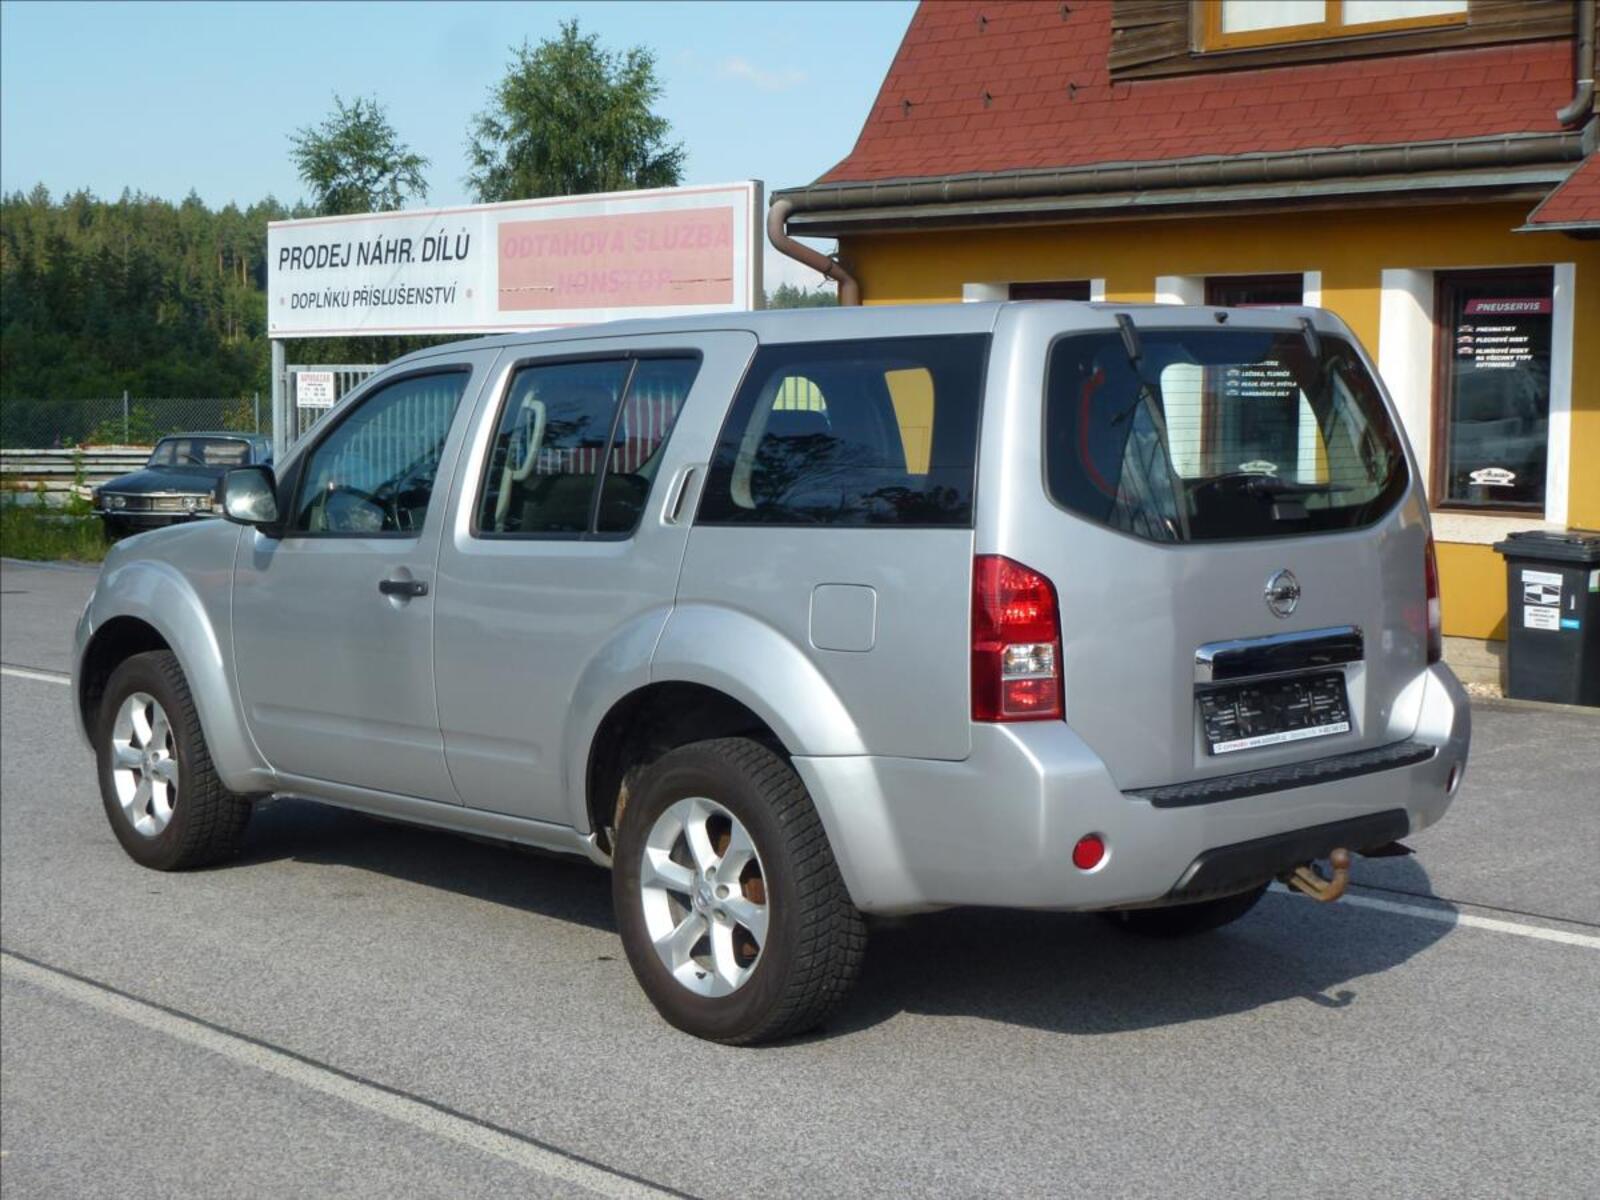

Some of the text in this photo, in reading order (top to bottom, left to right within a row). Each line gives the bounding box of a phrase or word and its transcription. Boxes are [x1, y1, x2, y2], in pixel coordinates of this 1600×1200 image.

[279, 227, 470, 270] PRODEJ NÁHR. DÍLŮ
[353, 281, 456, 307] PŘÍSLUŠENSTVÍ
[1476, 302, 1541, 312] PNEUSERVIS
